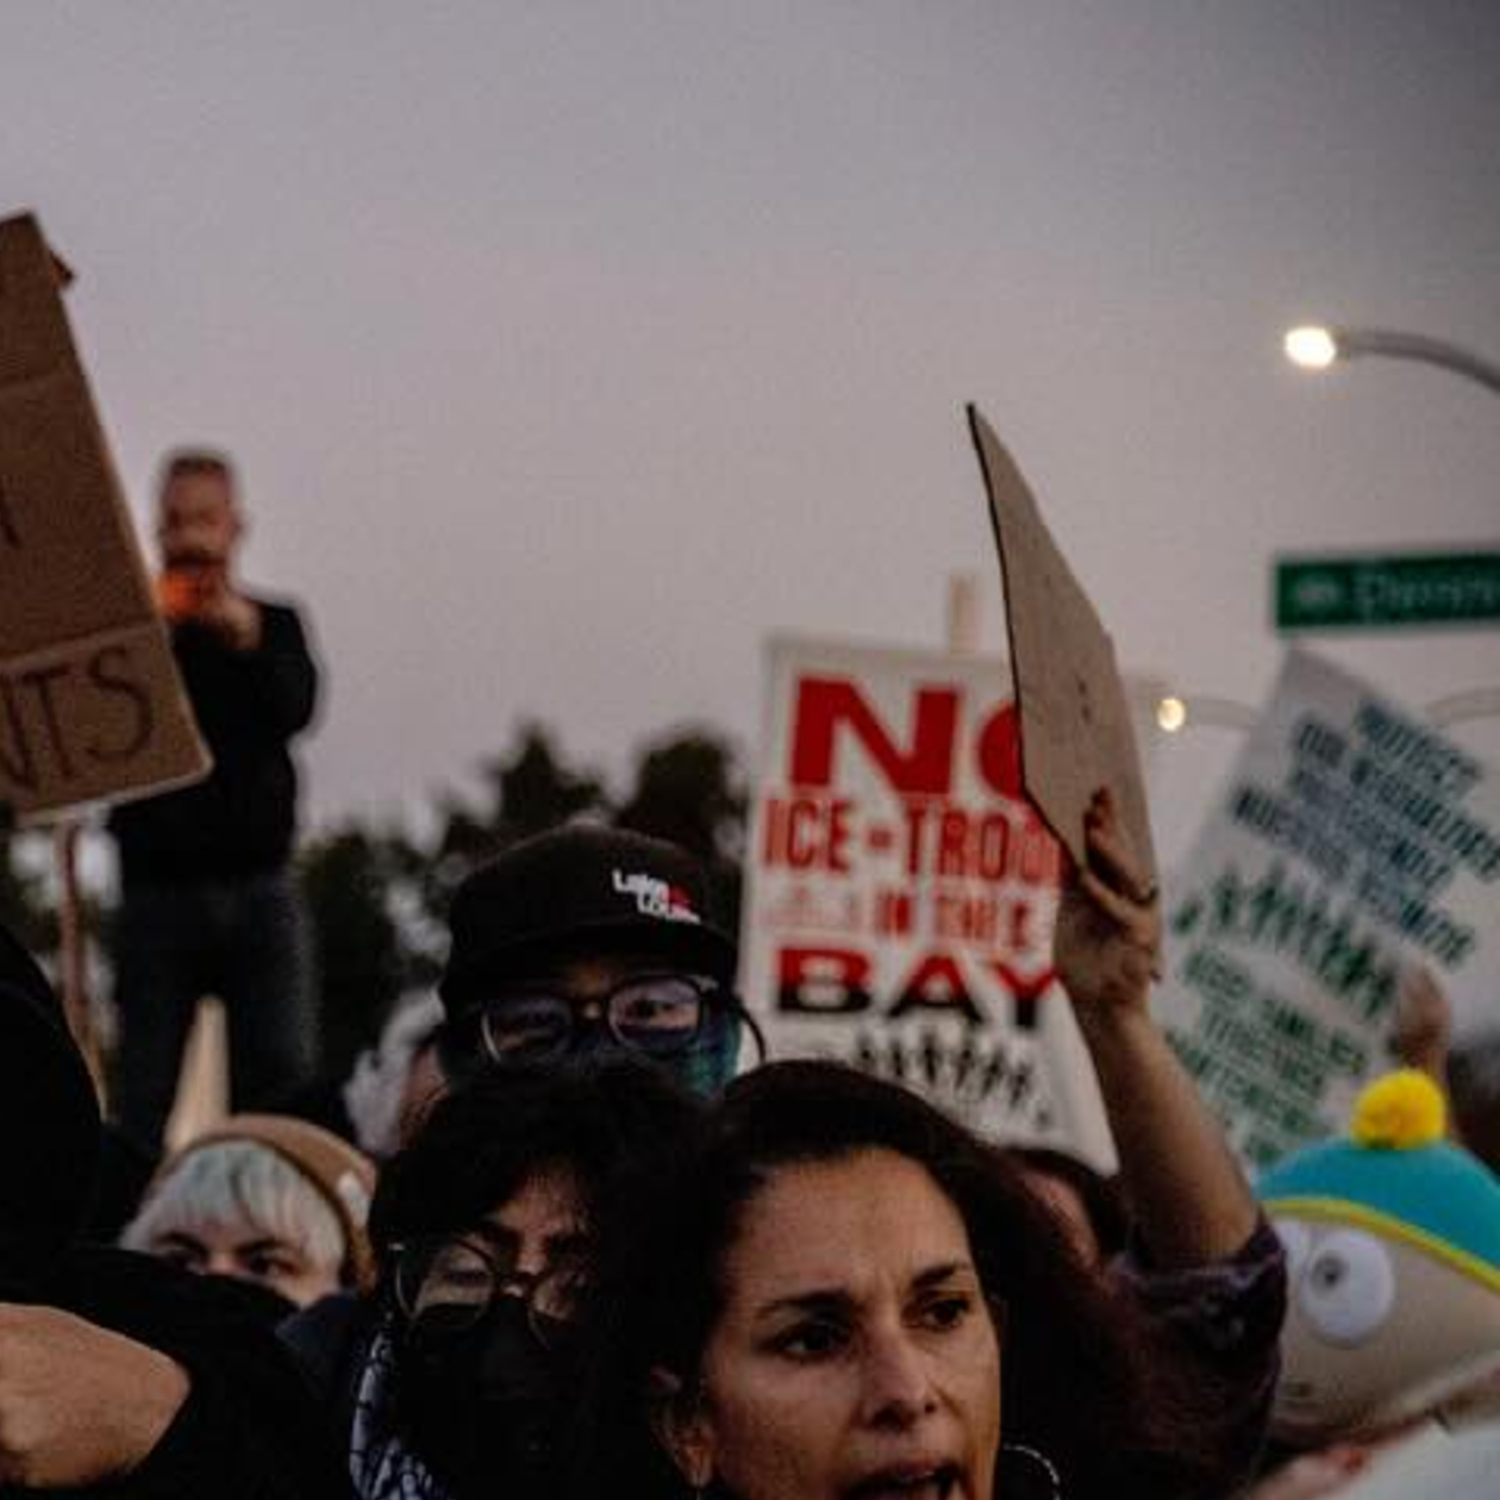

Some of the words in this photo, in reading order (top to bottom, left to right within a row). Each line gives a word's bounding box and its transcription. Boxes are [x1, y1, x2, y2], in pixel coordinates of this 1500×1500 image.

[761, 798, 851, 871] ICE
[904, 799, 1062, 886] TROO
[777, 947, 1058, 1029] BAY
